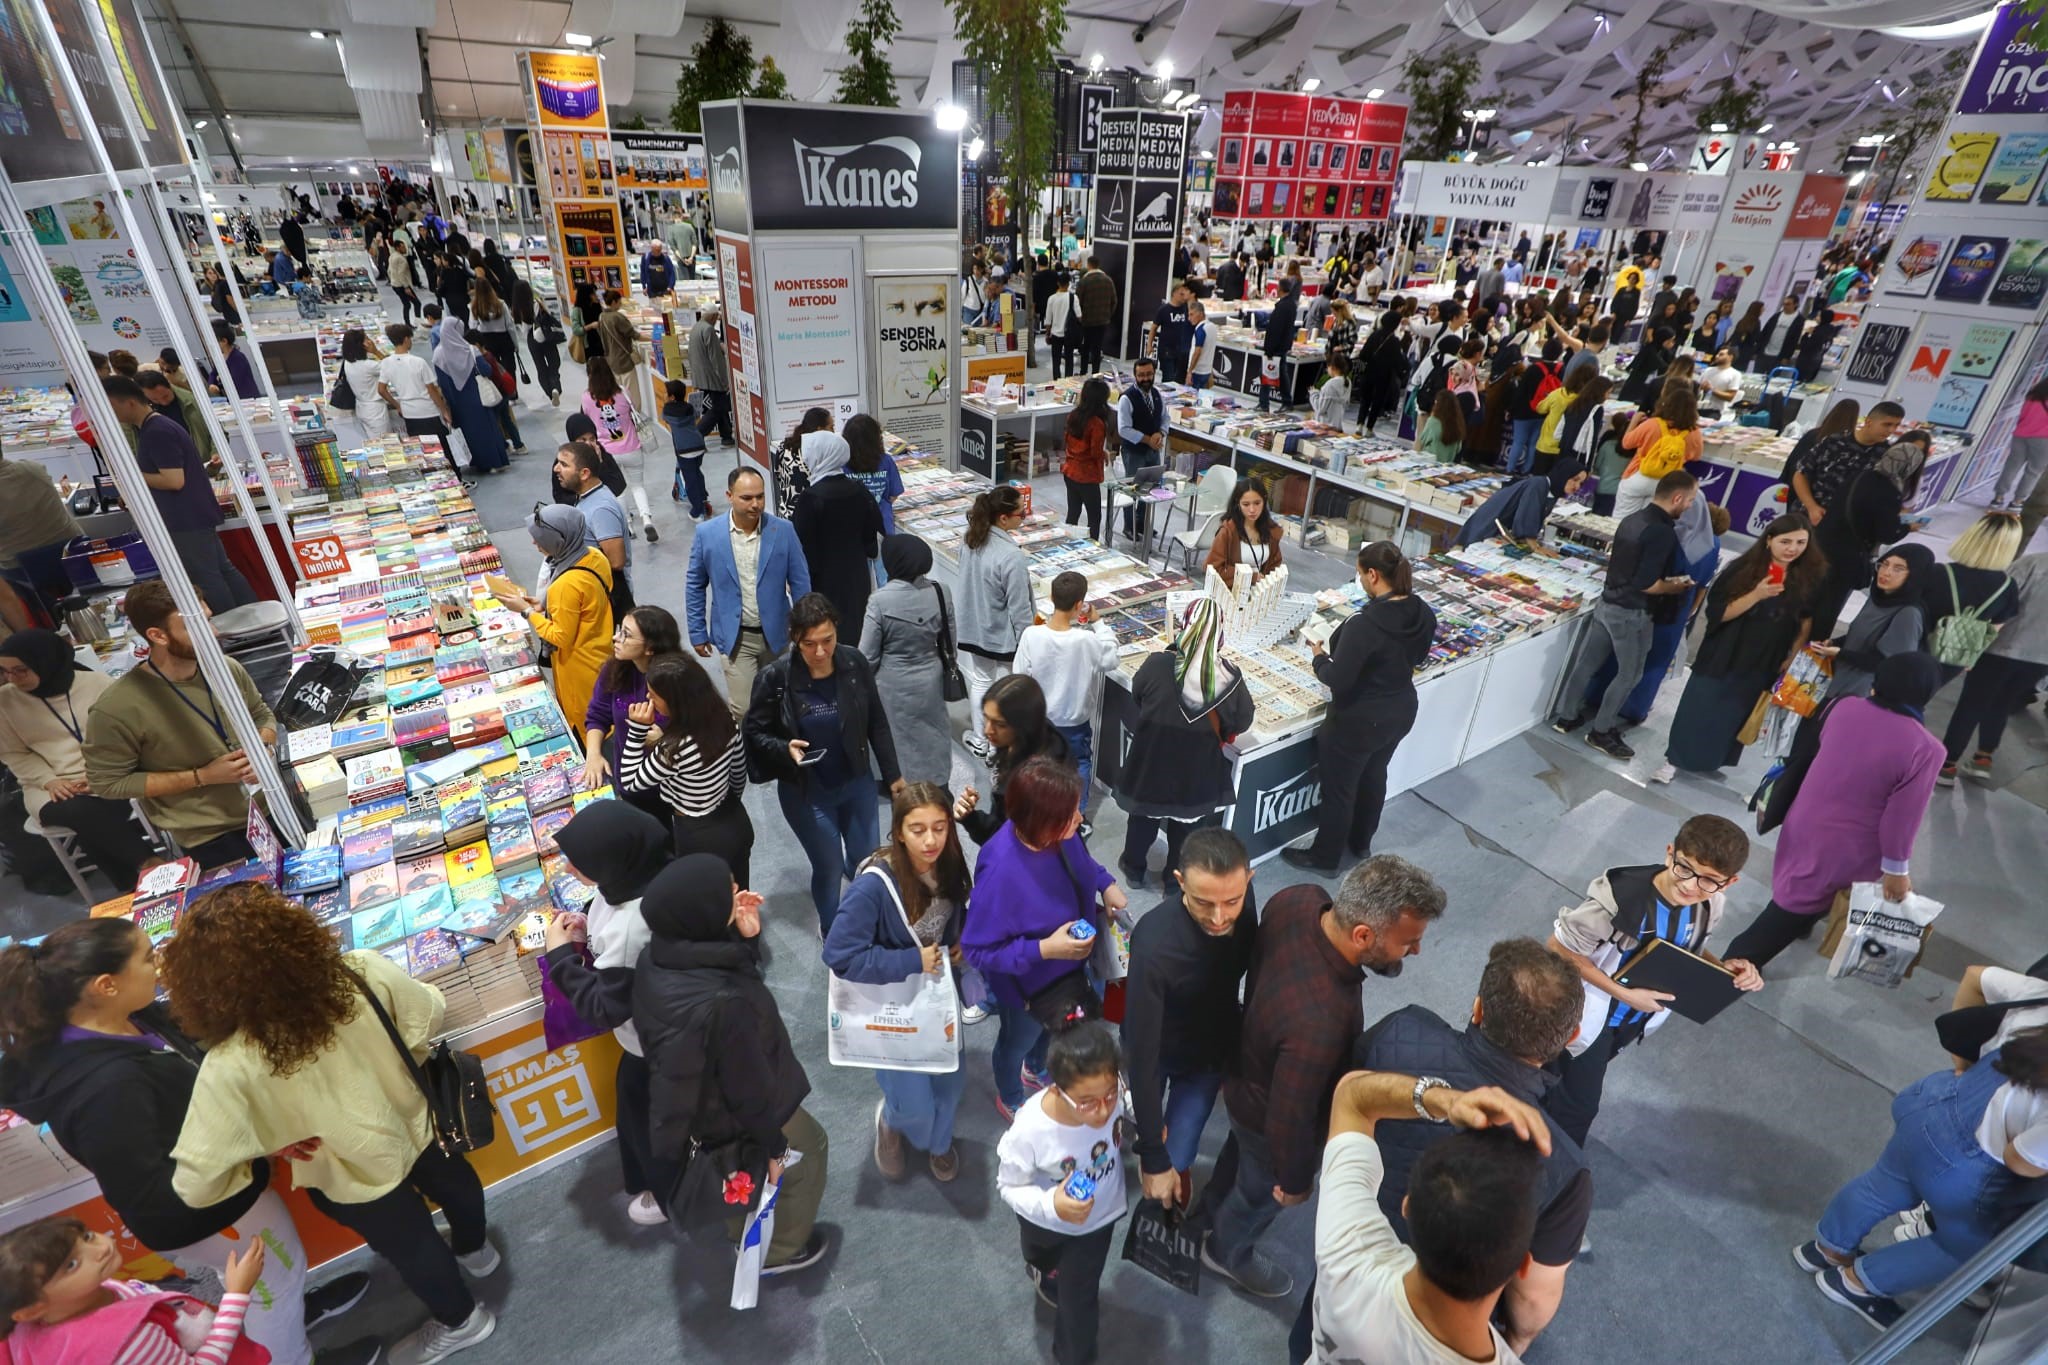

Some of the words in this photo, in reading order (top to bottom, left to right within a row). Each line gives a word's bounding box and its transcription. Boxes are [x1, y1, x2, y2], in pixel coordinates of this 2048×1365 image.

[1102, 121, 1136, 134] DESTEK
[1141, 122, 1183, 138] DESTEK
[1101, 137, 1135, 150] MEDYA
[1140, 138, 1181, 154] MEDYA
[1100, 153, 1135, 167] GRUBU
[1139, 155, 1180, 170] GRUBU
[714, 160, 741, 193] Kanes
[807, 153, 919, 209] Kanes
[1444, 173, 1486, 189] BÜYÜK
[1490, 176, 1530, 192] DOĞU
[1449, 192, 1516, 208] YAYINLARI
[1134, 219, 1173, 232] KARAKARGA
[1731, 213, 1772, 227] iletişim
[774, 278, 848, 291] MONTESSORI
[788, 295, 837, 307] METODU
[778, 331, 802, 341] Maria
[804, 328, 851, 340] Montessori
[881, 326, 935, 341] SENDEN
[900, 338, 947, 352] SONRA
[1850, 352, 1893, 382] MUSK
[840, 404, 852, 414] 50
[305, 558, 345, 576] İNDİRİM
[487, 1045, 581, 1094] TİMAŞ
